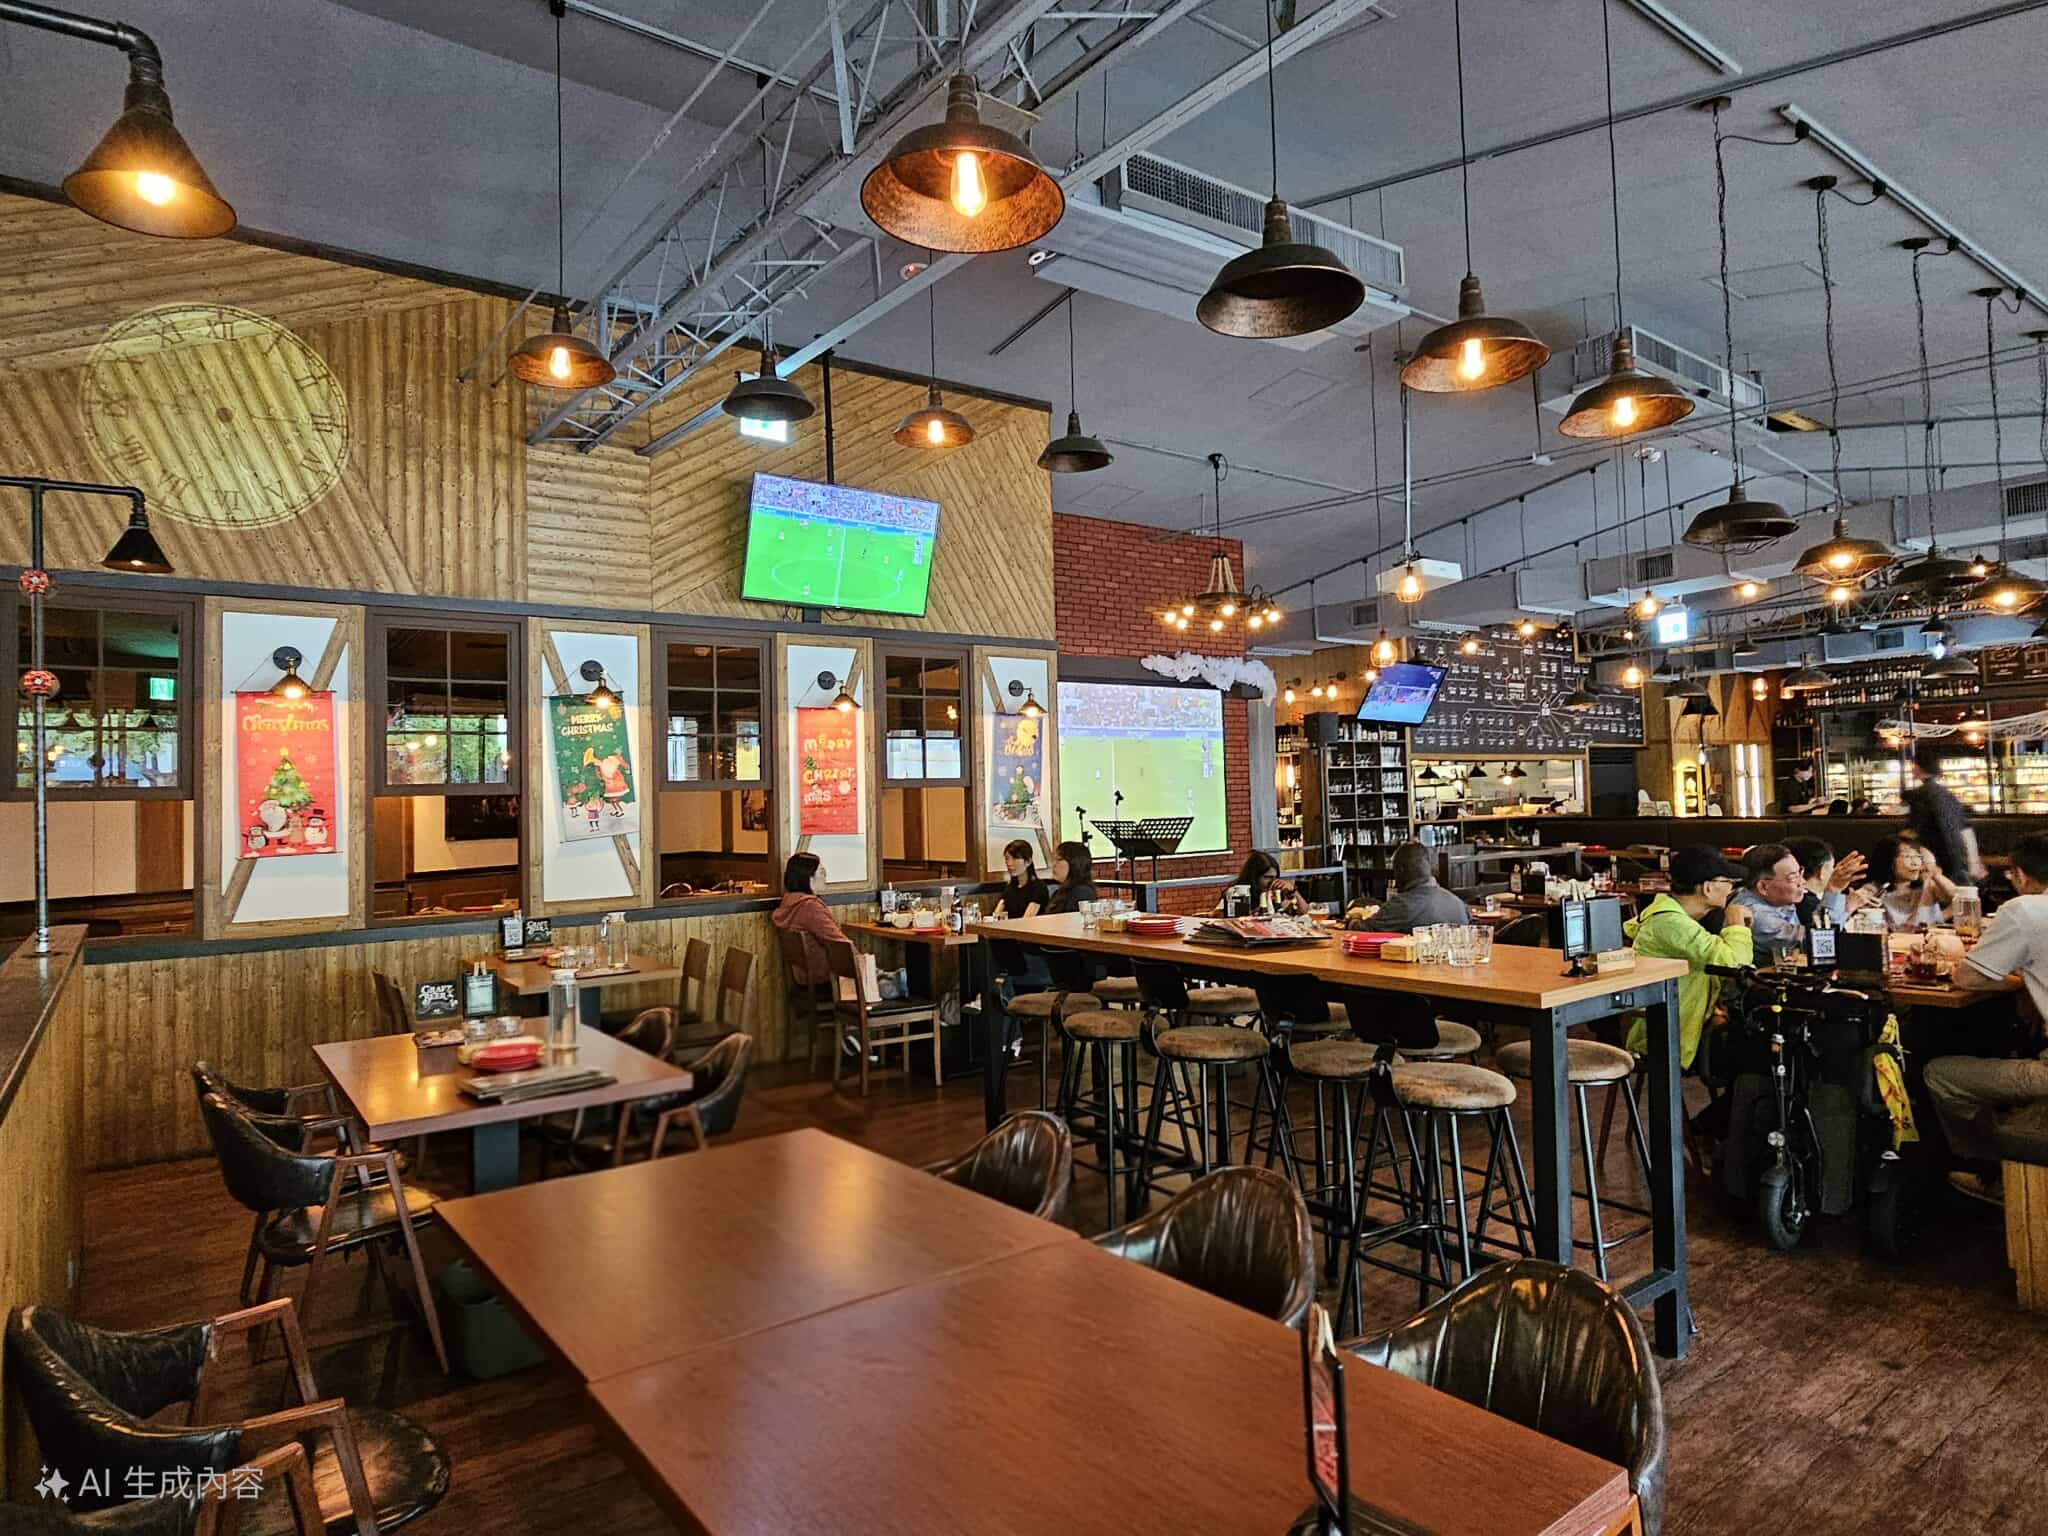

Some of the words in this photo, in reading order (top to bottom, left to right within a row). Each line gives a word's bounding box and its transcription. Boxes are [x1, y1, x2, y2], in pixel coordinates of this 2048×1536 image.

[206, 319, 236, 342] XII
[561, 723, 614, 736] CHRISTMAS
[421, 984, 455, 994] CRAFT
